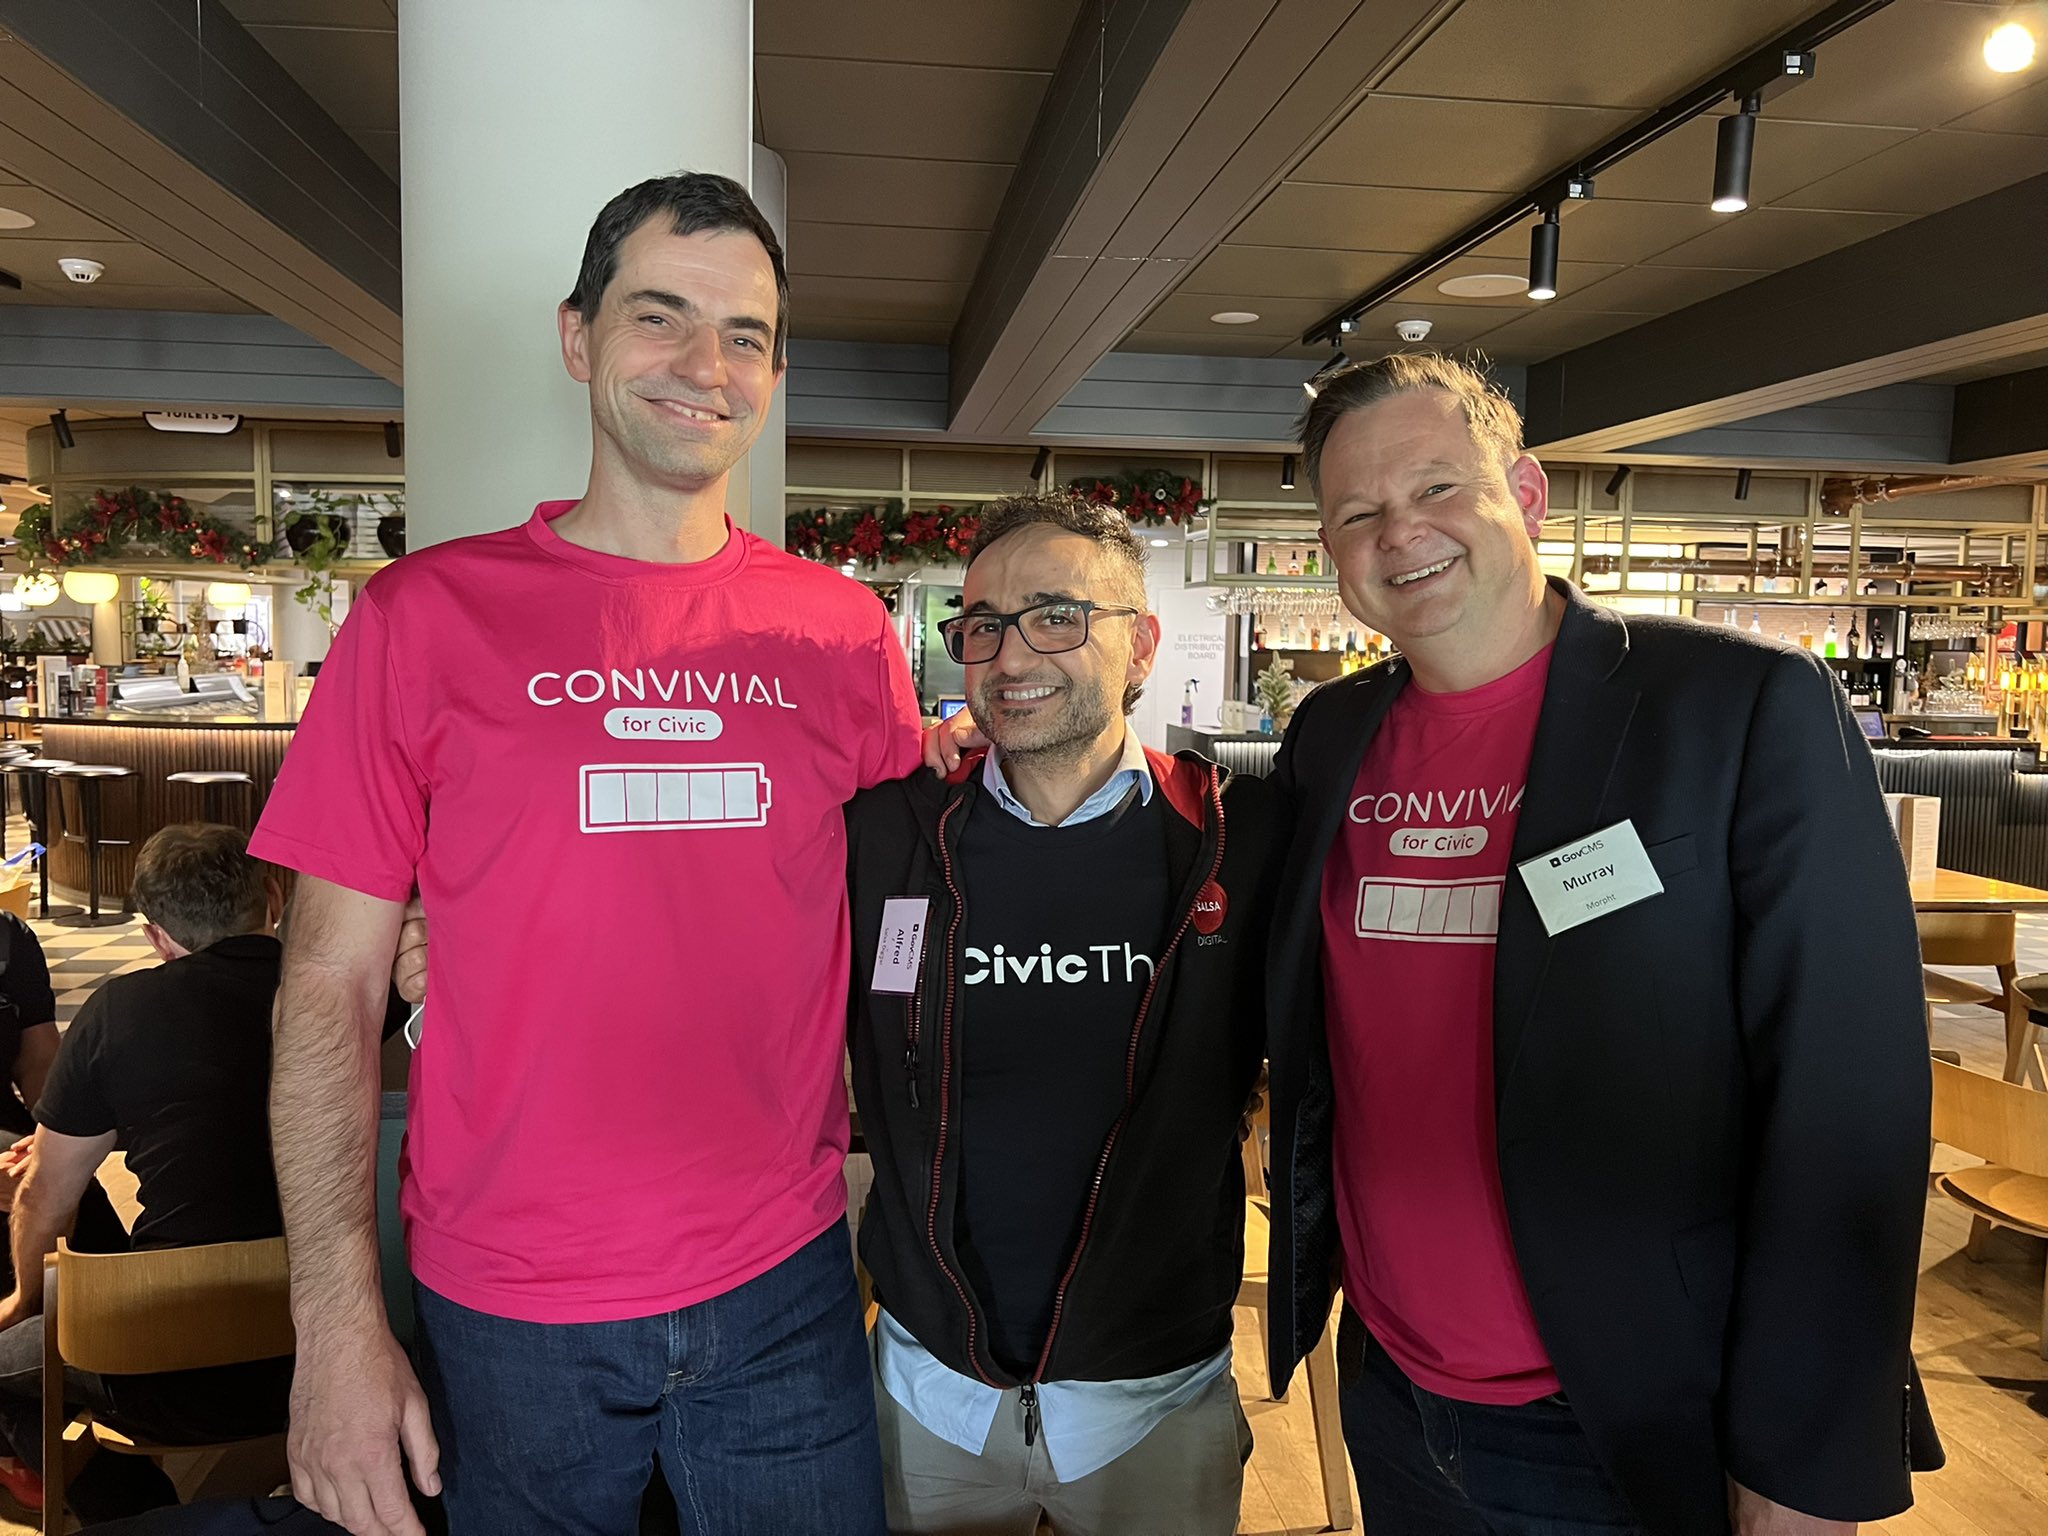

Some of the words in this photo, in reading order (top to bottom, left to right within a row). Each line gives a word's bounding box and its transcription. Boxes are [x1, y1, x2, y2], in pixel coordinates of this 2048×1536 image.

[1187, 652, 1216, 660] BOARD
[527, 668, 798, 709] CONVIVIAL
[622, 716, 651, 732] for
[658, 716, 706, 734] Civic
[1402, 835, 1429, 850] for
[1434, 833, 1475, 851] Civic
[1561, 840, 1605, 863] GovCMS
[1562, 863, 1615, 892] Murray
[1197, 901, 1221, 912] SALSA
[1585, 894, 1616, 911] Morpht
[892, 928, 905, 965] Alfred
[906, 933, 918, 970] GovCMS
[964, 942, 1155, 985] CivicTh
